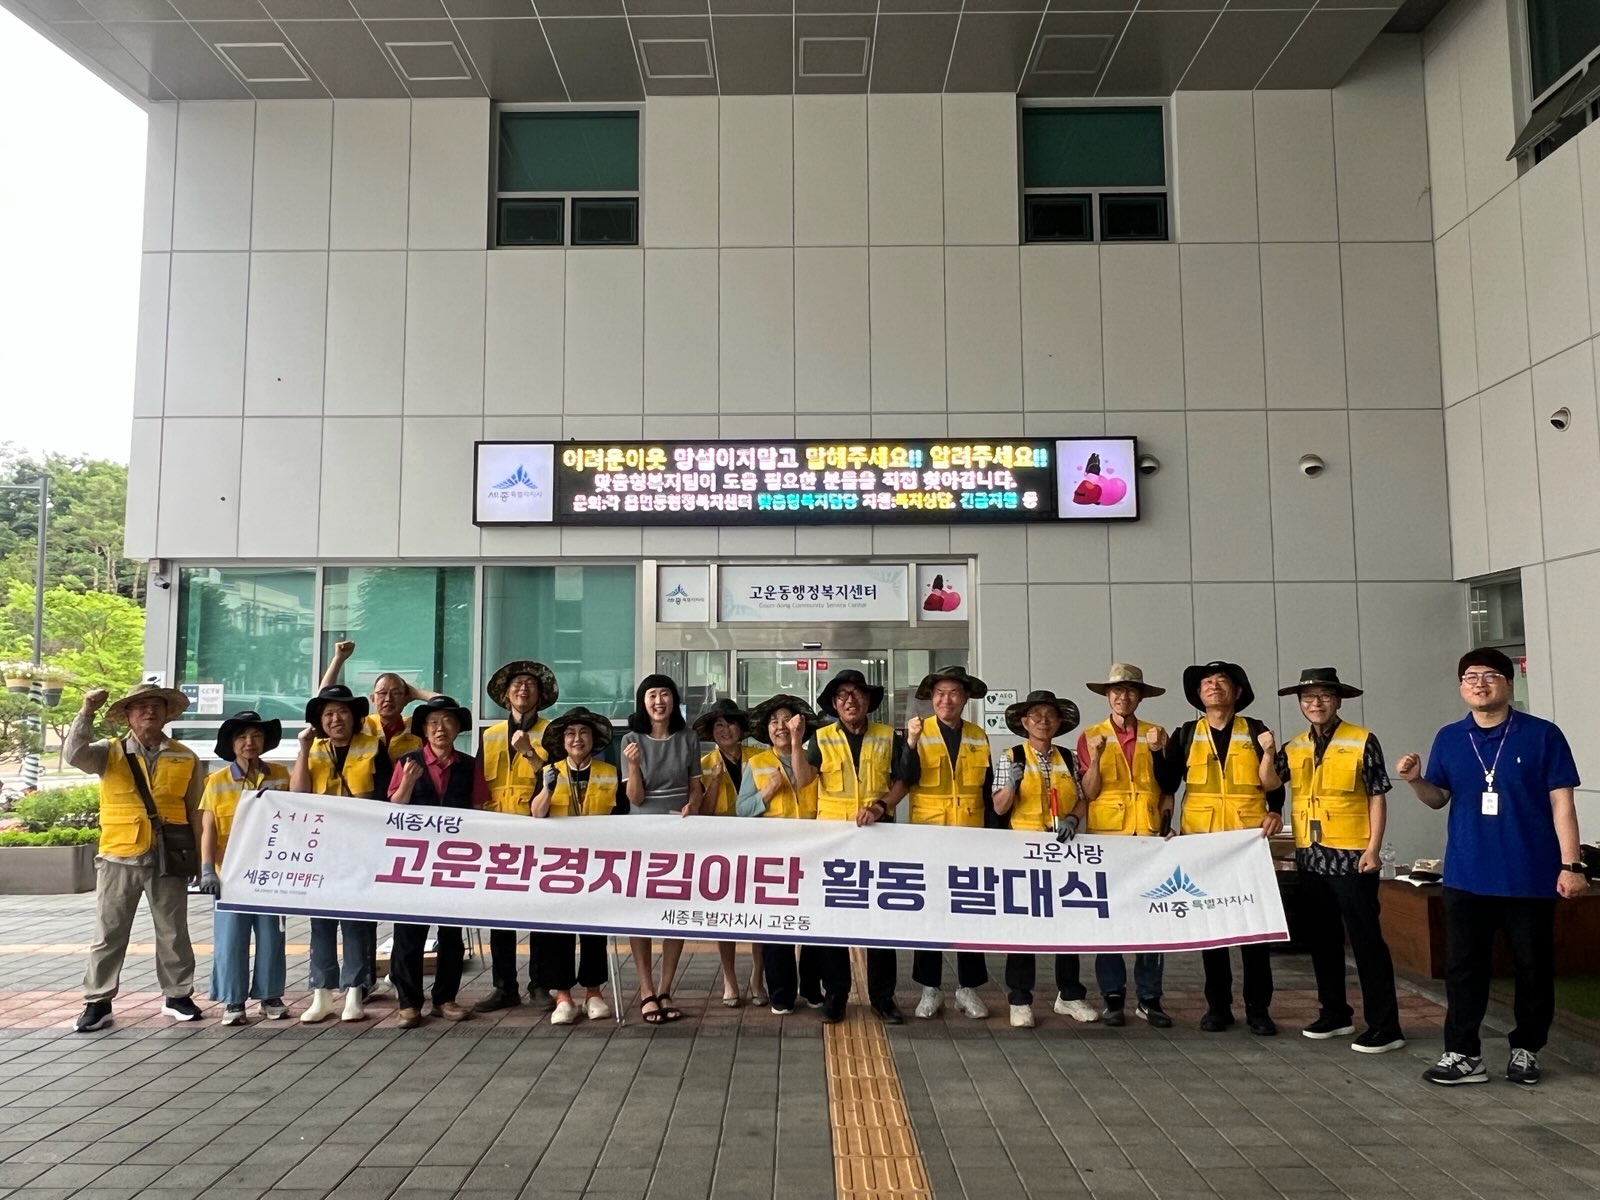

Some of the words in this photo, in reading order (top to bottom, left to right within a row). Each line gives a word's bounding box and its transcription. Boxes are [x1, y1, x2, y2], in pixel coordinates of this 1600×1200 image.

[562, 447, 668, 472] 어려운이웃
[673, 447, 800, 471] 망설이지말고
[763, 471, 818, 491] 필요한
[822, 470, 877, 491] 분들을
[748, 584, 878, 601] 고운동행정복지센터
[385, 811, 464, 835] 세종사랑
[1022, 842, 1104, 865] 고운사랑
[243, 869, 284, 887] 세종이
[286, 871, 325, 889] 미래다
[375, 838, 805, 906] 고운환경지킴이단
[821, 858, 927, 913] 활동
[947, 864, 1111, 919] 발대식
[660, 908, 763, 929] 세종특별자치시
[767, 914, 812, 932] 고운동
